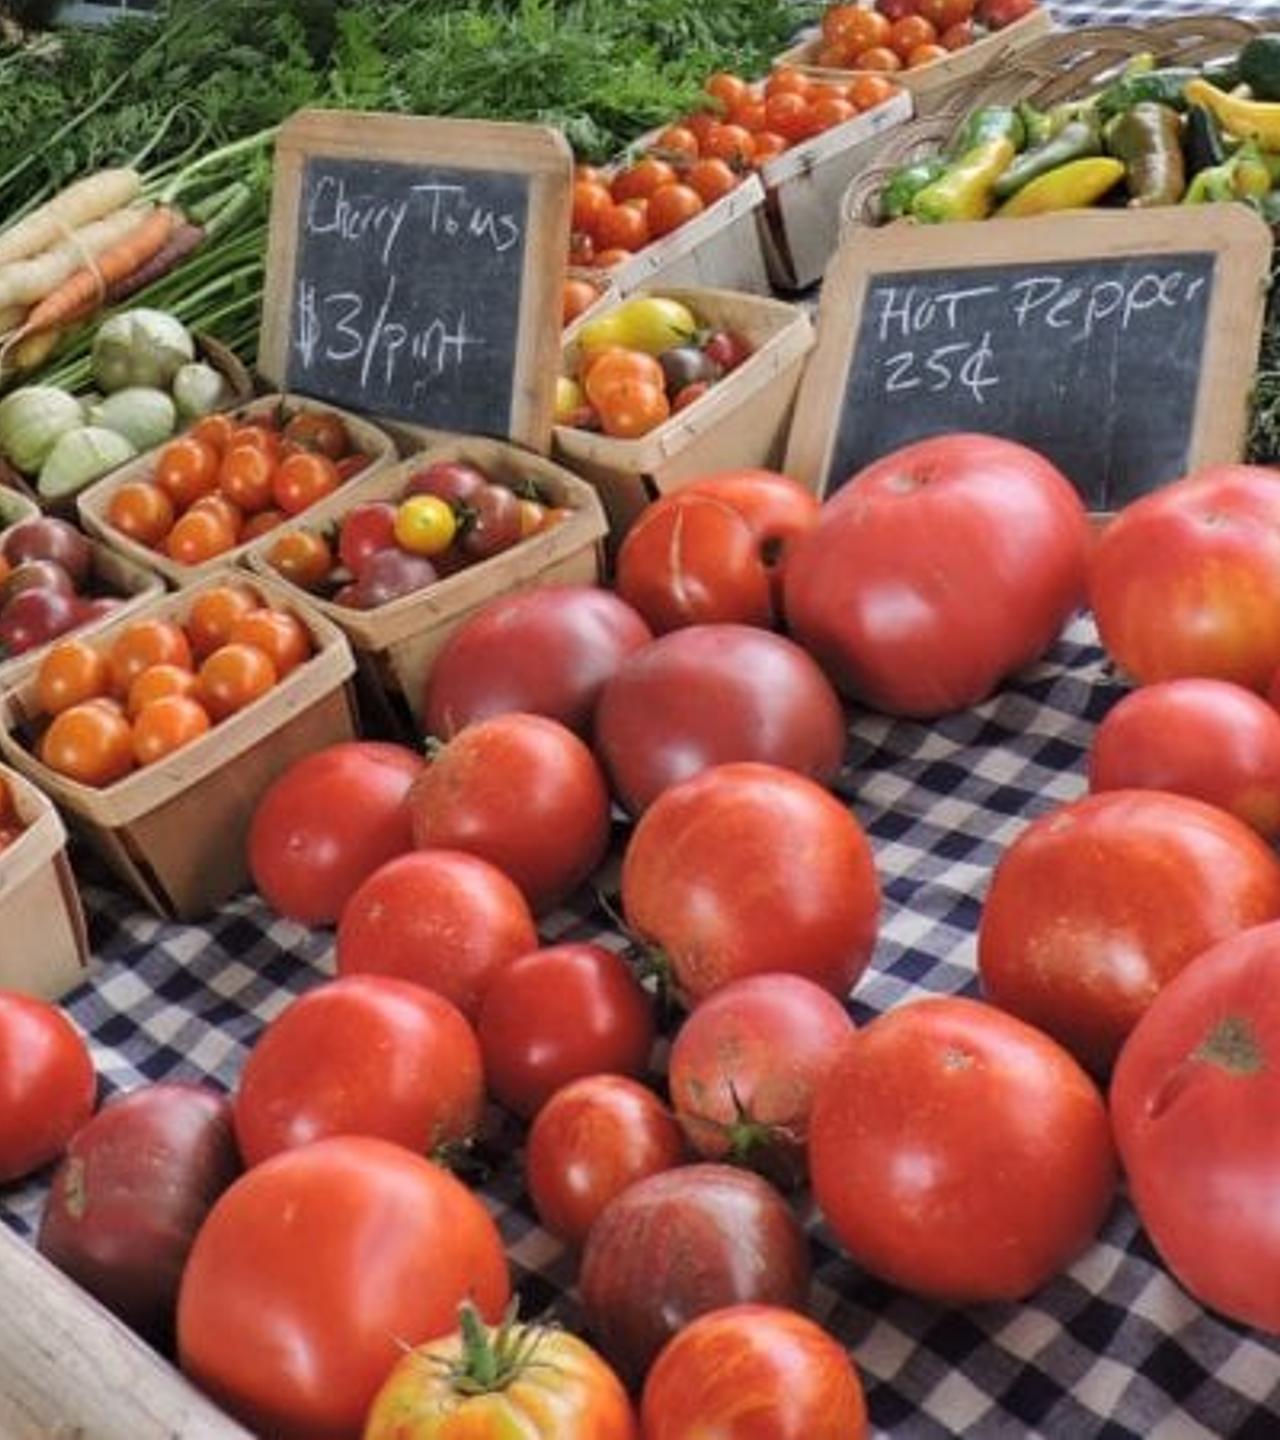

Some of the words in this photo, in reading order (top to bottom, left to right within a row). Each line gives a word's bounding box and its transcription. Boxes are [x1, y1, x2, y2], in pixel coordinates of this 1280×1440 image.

[307, 176, 407, 265] Cherry
[410, 185, 520, 252] Toms
[296, 274, 487, 387] $3/pint
[1012, 270, 1206, 343] Pepper
[884, 331, 1001, 404] 25¢
